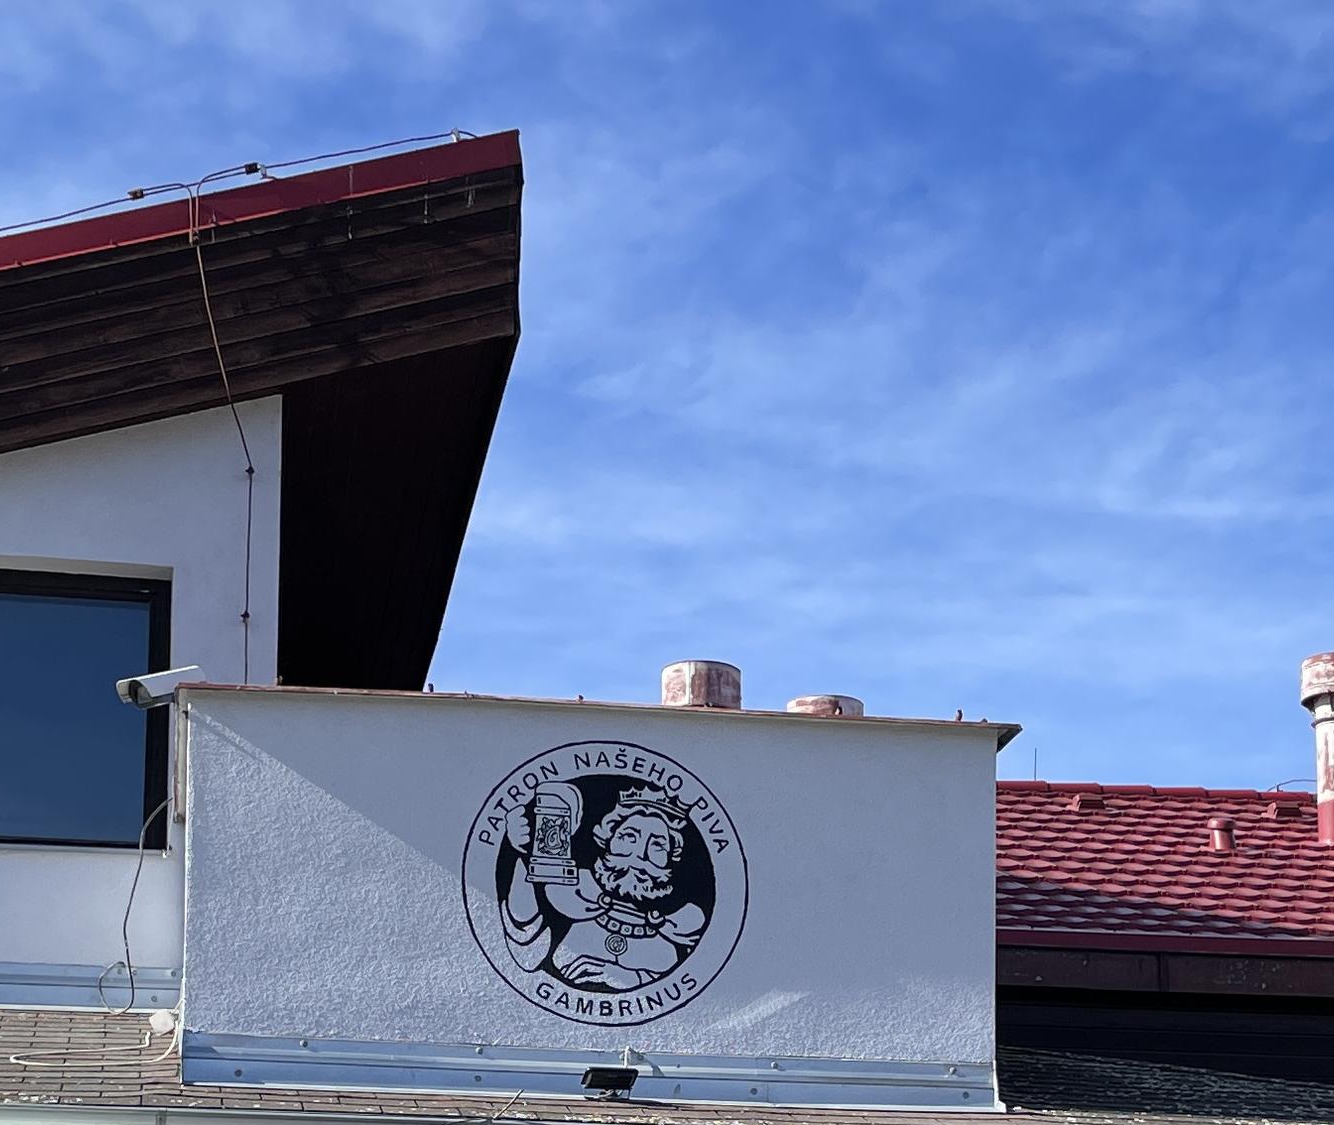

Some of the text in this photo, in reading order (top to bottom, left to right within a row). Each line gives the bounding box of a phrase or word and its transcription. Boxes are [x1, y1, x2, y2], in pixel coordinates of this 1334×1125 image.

[479, 748, 730, 855] PATRON NAŠEHO PIVA
[536, 973, 698, 1017] GAMBRINUS
